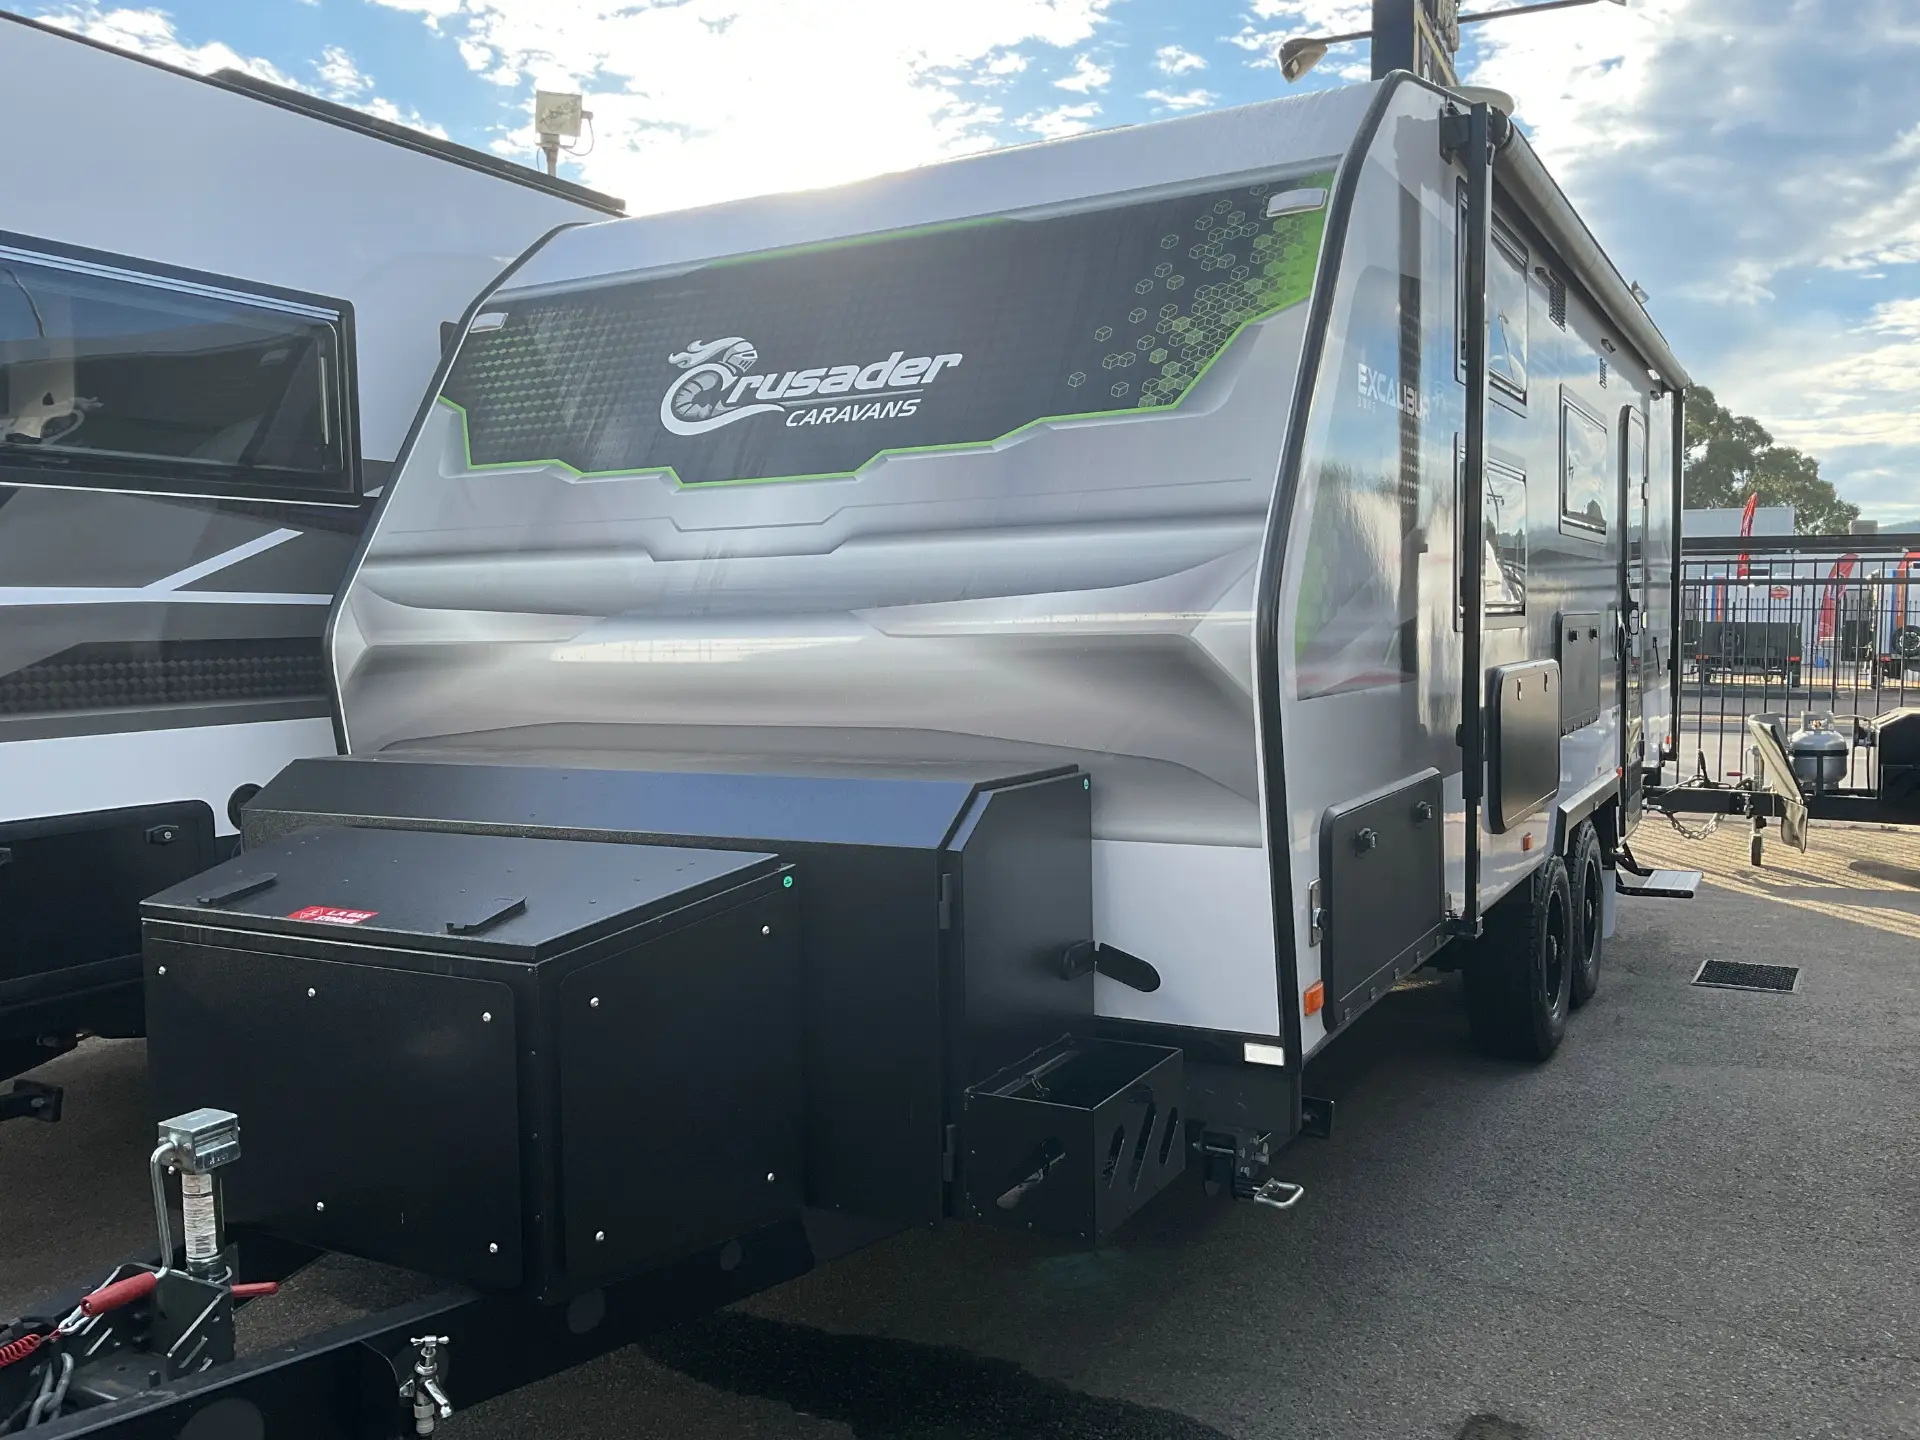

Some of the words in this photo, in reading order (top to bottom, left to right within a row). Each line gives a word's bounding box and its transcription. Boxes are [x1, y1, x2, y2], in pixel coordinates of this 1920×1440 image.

[661, 351, 963, 435] Crusader
[786, 398, 922, 427] CARAVANS
[1358, 363, 1431, 422] EXCALIBUR
